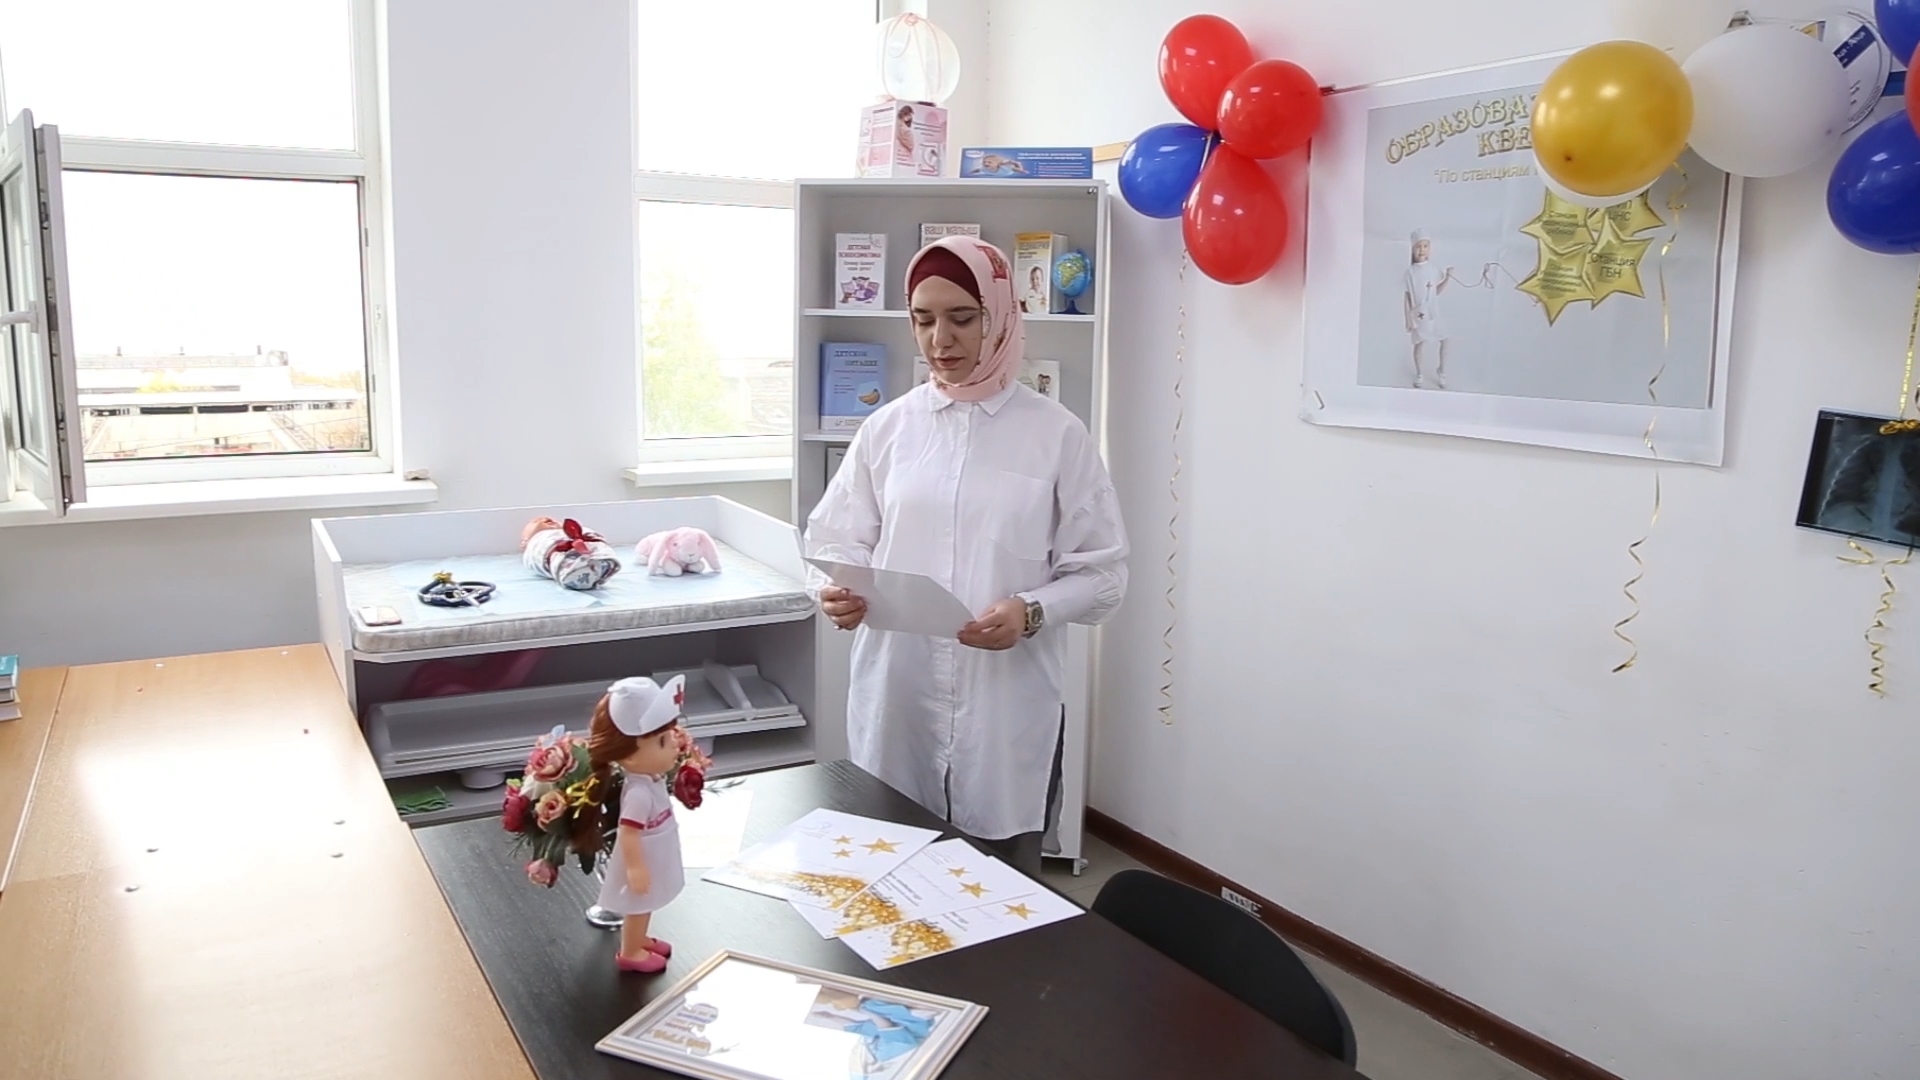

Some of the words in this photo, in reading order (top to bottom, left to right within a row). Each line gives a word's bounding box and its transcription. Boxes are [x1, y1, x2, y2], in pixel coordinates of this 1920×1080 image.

[1477, 124, 1533, 158] КВЕ
[1462, 165, 1530, 182] станциям
[1590, 252, 1636, 267] Станция
[1600, 266, 1622, 279] ГБН
